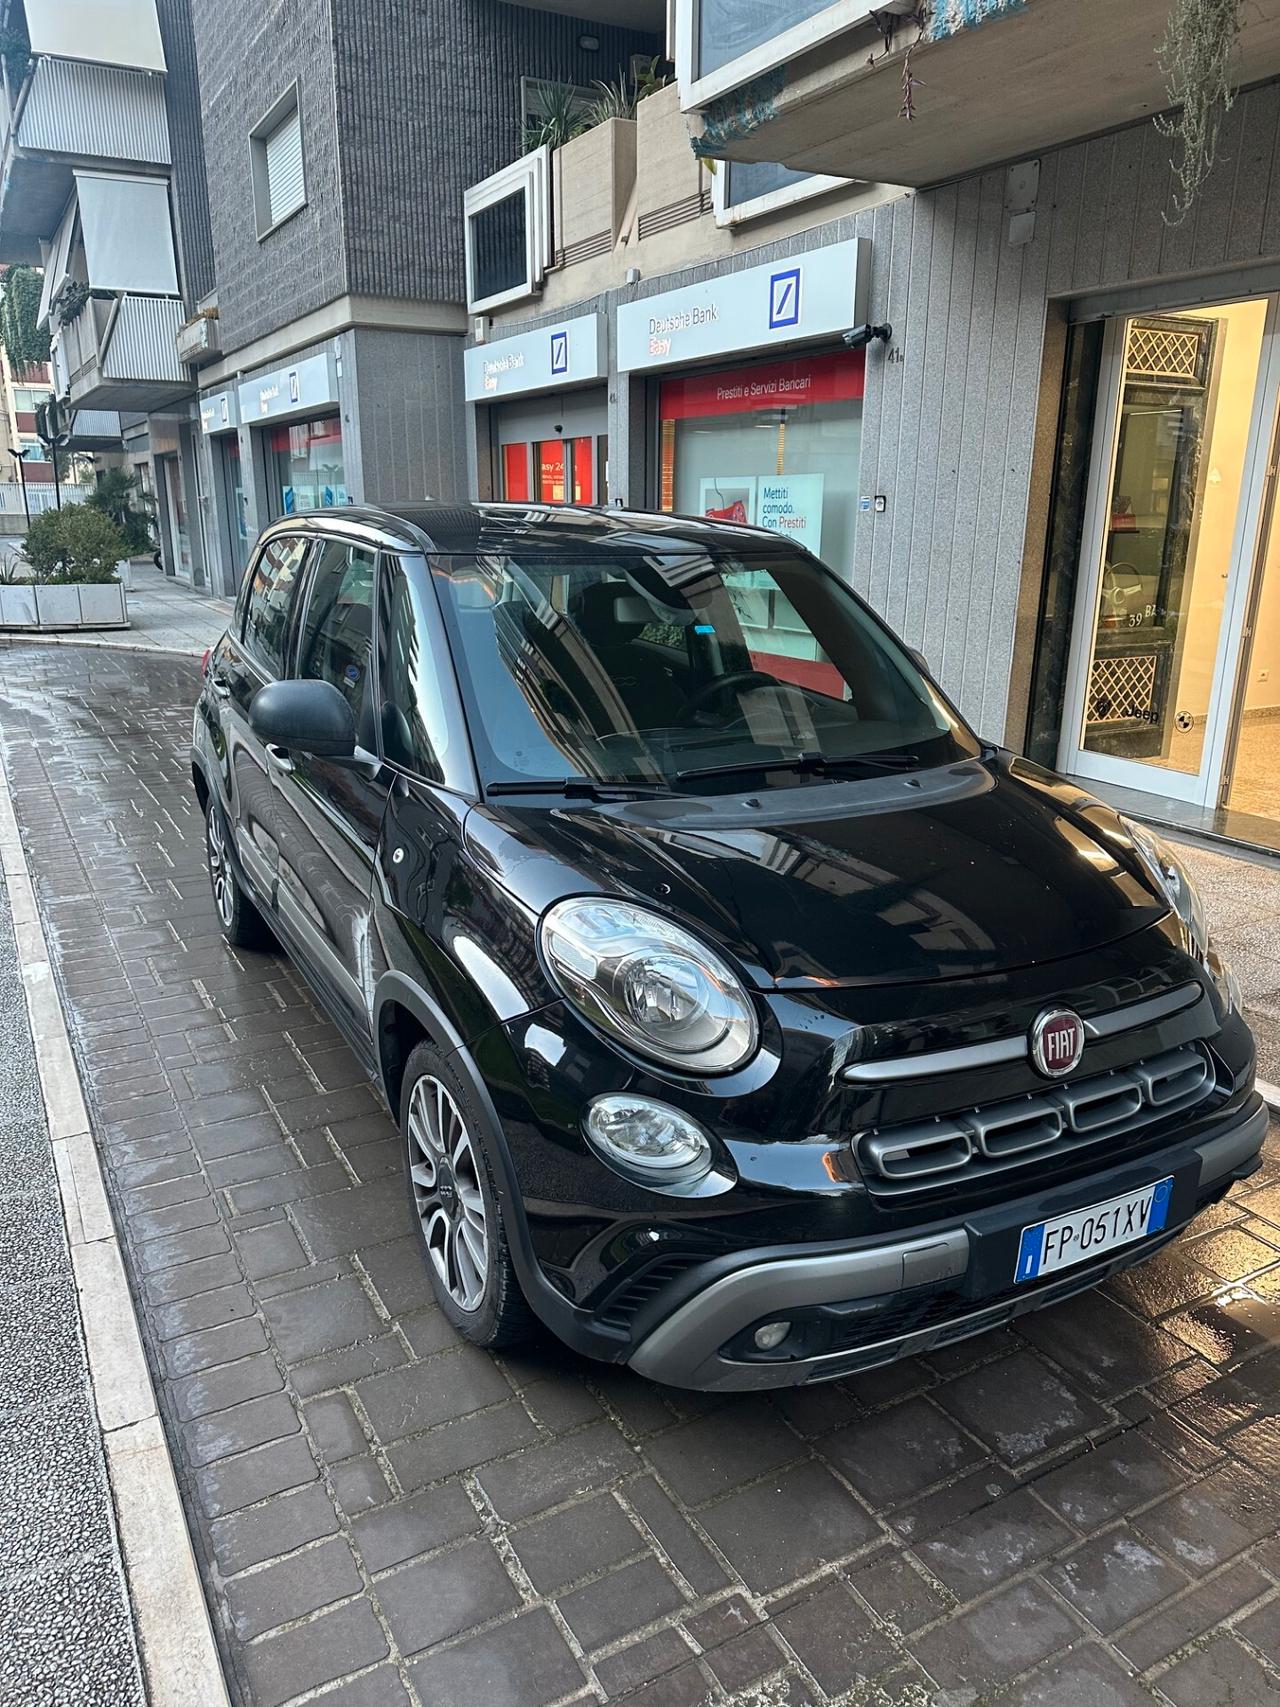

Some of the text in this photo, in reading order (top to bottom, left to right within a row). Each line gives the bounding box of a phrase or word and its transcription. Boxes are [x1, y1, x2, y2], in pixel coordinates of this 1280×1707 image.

[649, 303, 718, 335] Deutsche Bank
[649, 336, 671, 357] Easy
[717, 374, 811, 400] Prestiti e Servizi Bancari
[541, 463, 554, 473] asy
[763, 487, 789, 499] Mettiti
[762, 502, 795, 514] comodo.
[762, 516, 807, 529] Con Prestiti
[1128, 612, 1143, 628] 39
[1126, 703, 1159, 725] Jeep
[1047, 1027, 1076, 1062] FIAT
